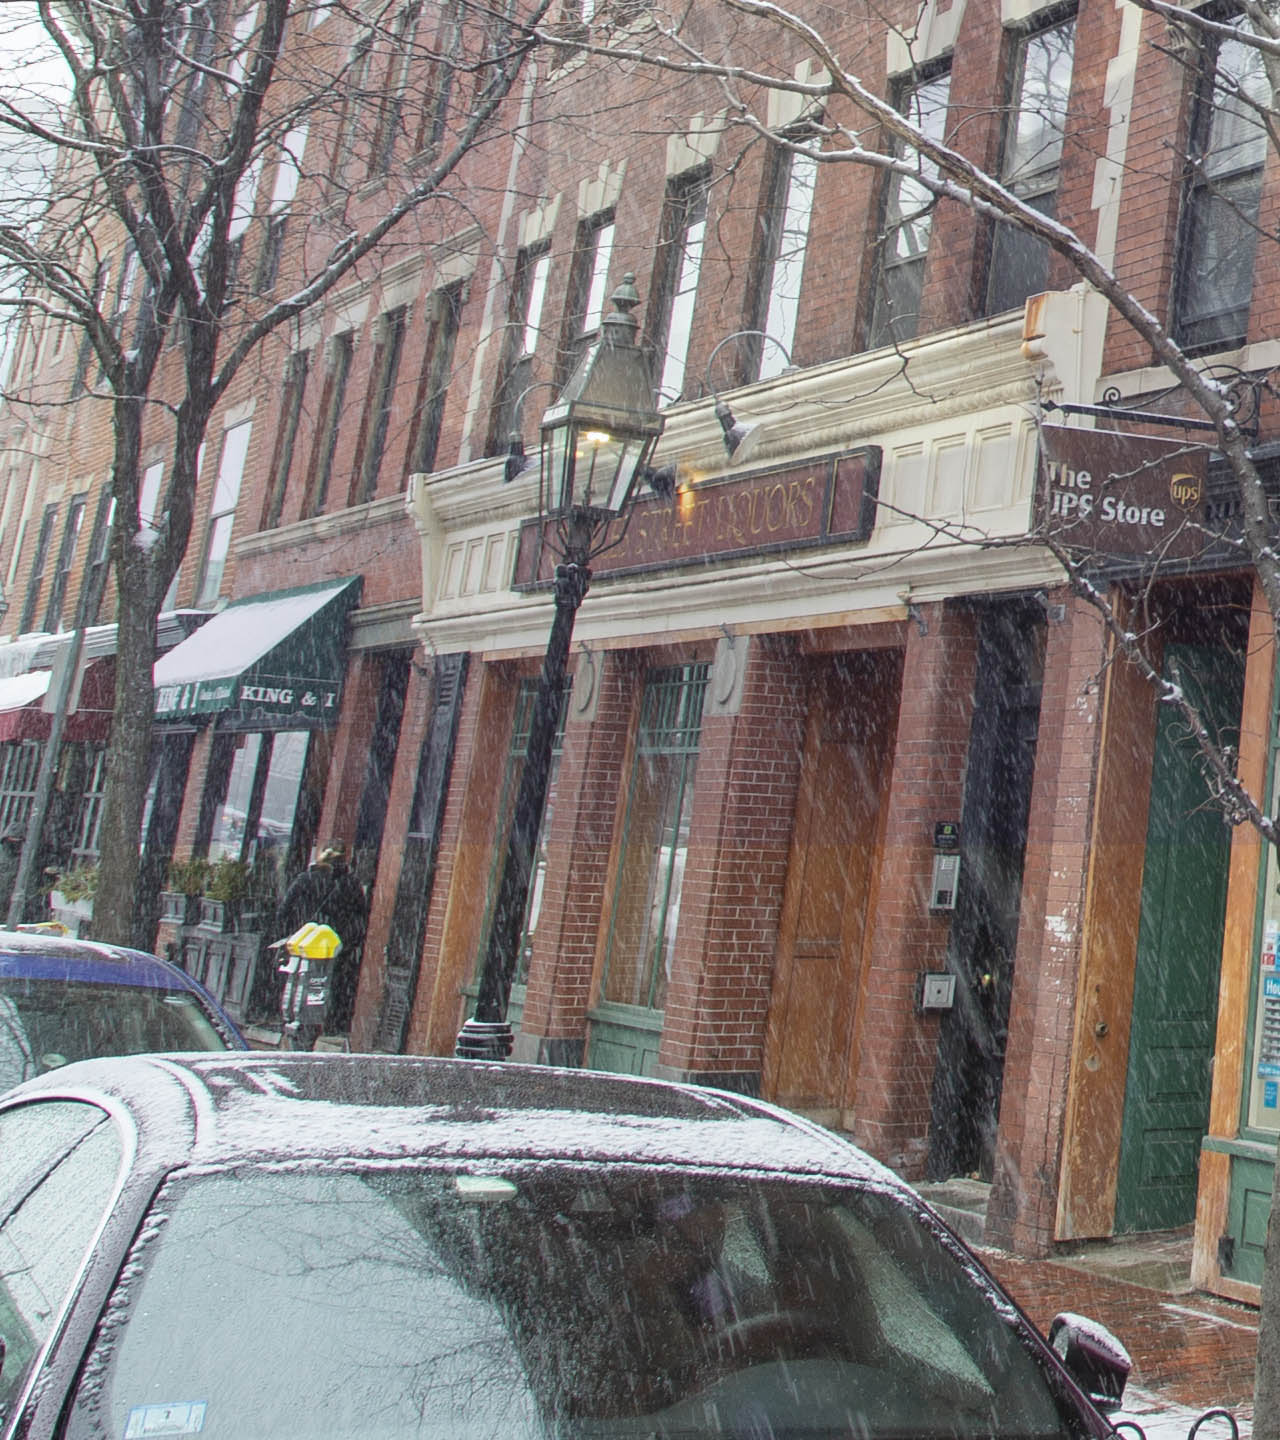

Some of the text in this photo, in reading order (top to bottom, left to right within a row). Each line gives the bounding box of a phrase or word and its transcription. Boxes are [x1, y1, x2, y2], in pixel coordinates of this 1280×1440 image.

[1047, 461, 1091, 488] The
[1173, 483, 1199, 505] ups
[715, 477, 816, 544] LIQUORS
[1101, 496, 1165, 527] Store
[240, 685, 294, 704] KING
[301, 691, 317, 706] &
[325, 693, 336, 708] I
